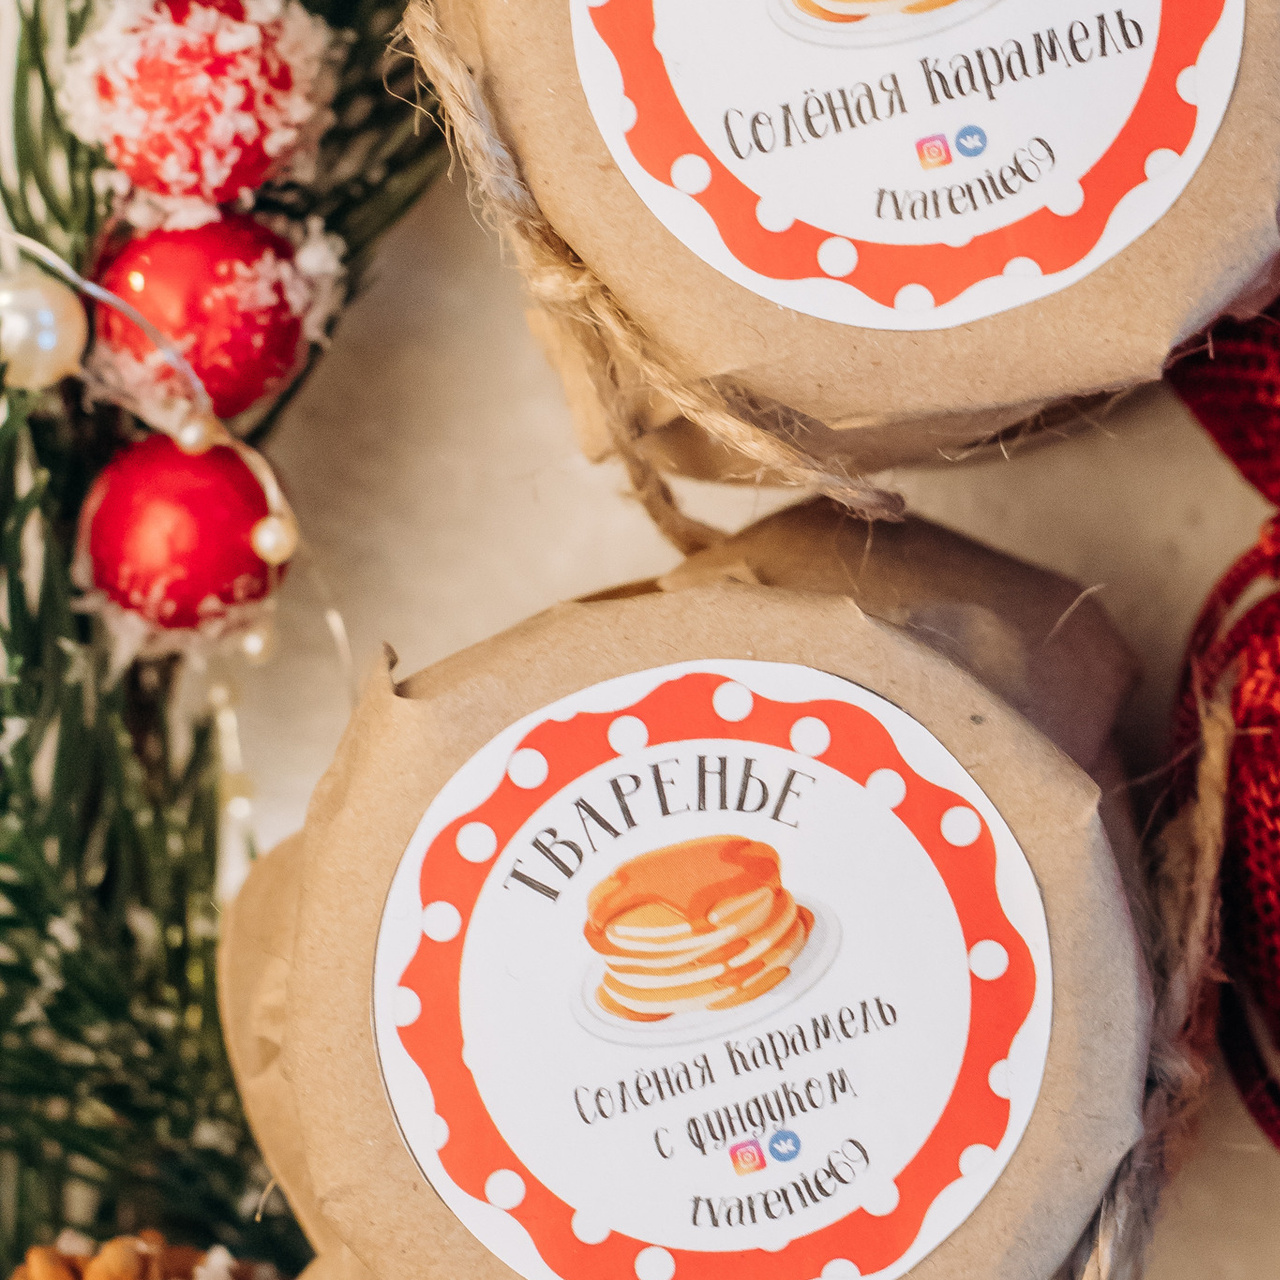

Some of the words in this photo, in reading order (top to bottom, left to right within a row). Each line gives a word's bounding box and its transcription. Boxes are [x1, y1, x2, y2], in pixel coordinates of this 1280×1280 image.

[722, 72, 908, 161] Солёная
[874, 136, 1056, 221] tvarenie69
[503, 755, 816, 902] ТВАРЕНЬЕ
[573, 1053, 715, 1125] Солёная
[687, 1068, 858, 1157] фундуком
[690, 1137, 870, 1227] tvarenie69
